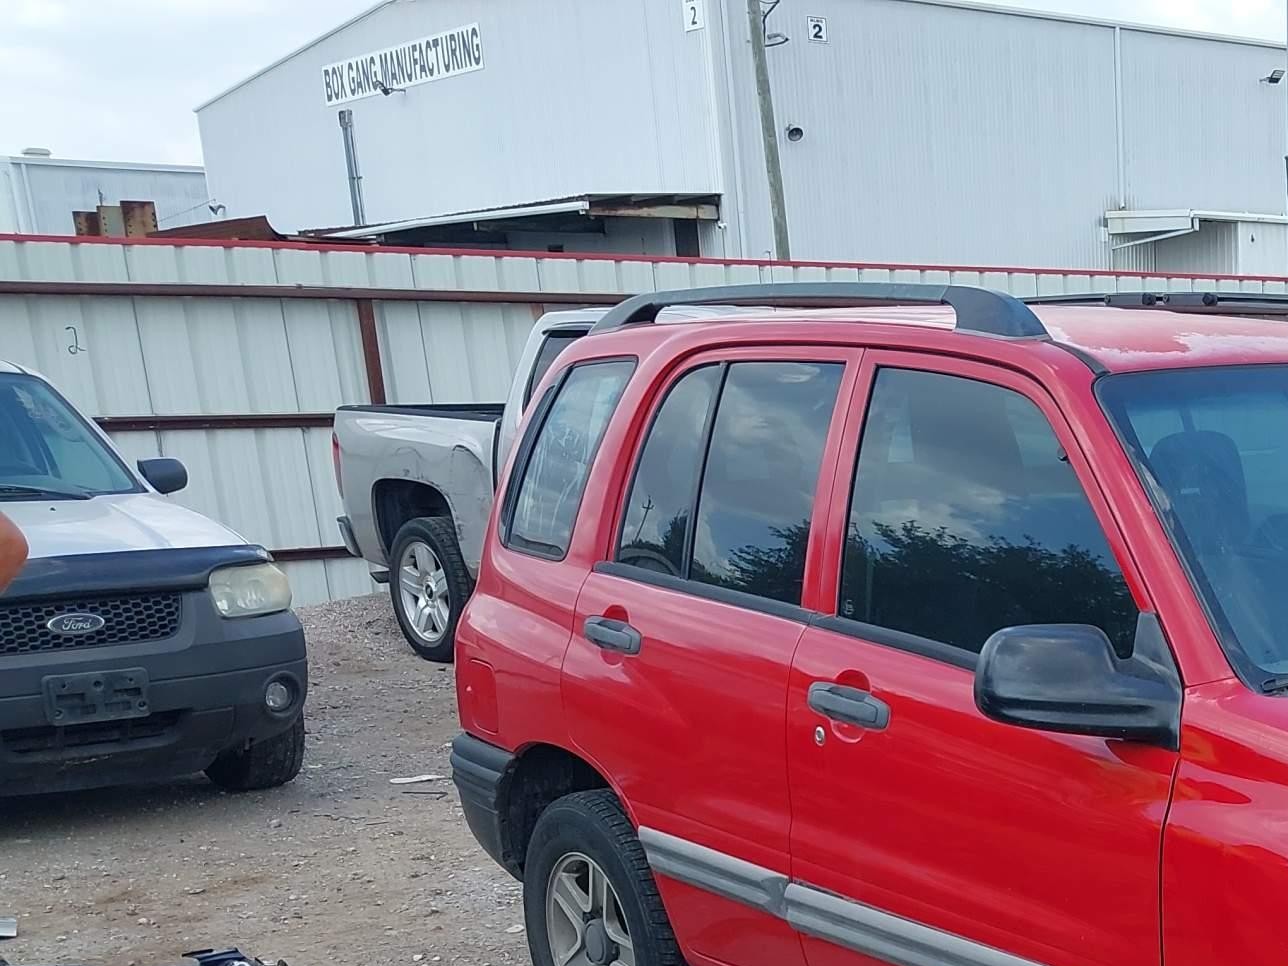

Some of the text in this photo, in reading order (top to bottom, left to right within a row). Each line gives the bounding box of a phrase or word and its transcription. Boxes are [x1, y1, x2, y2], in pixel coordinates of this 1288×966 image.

[690, 6, 698, 26] 2
[812, 24, 823, 39] 2
[323, 27, 481, 102] BOX GANG MANUFACTURING
[62, 617, 92, 631] Ford
